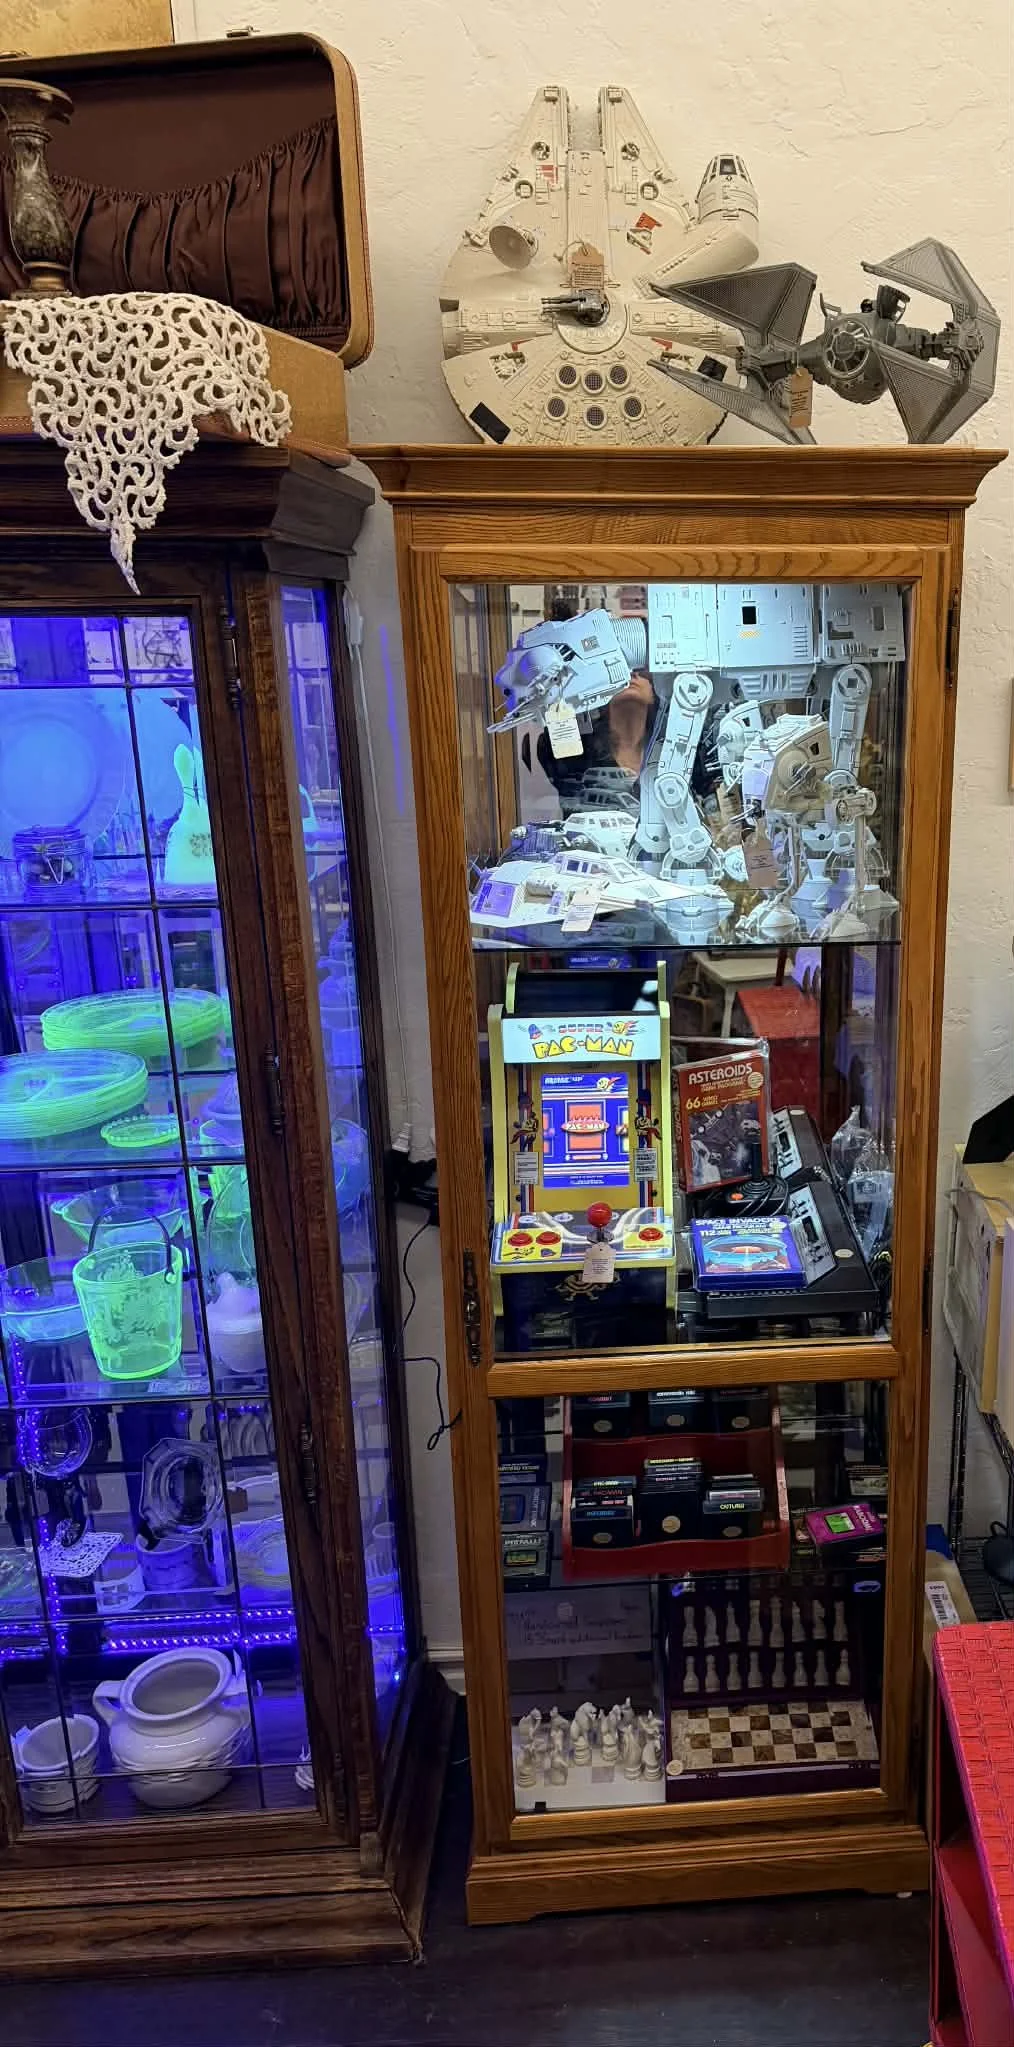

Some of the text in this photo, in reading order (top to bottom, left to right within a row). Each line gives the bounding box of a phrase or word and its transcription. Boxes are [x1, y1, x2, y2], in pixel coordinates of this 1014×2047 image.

[558, 1023, 604, 1034] SUPER
[532, 1035, 635, 1060] PAC-MAN
[688, 1062, 754, 1085] ASTEROIDS
[686, 1096, 701, 1110] 66
